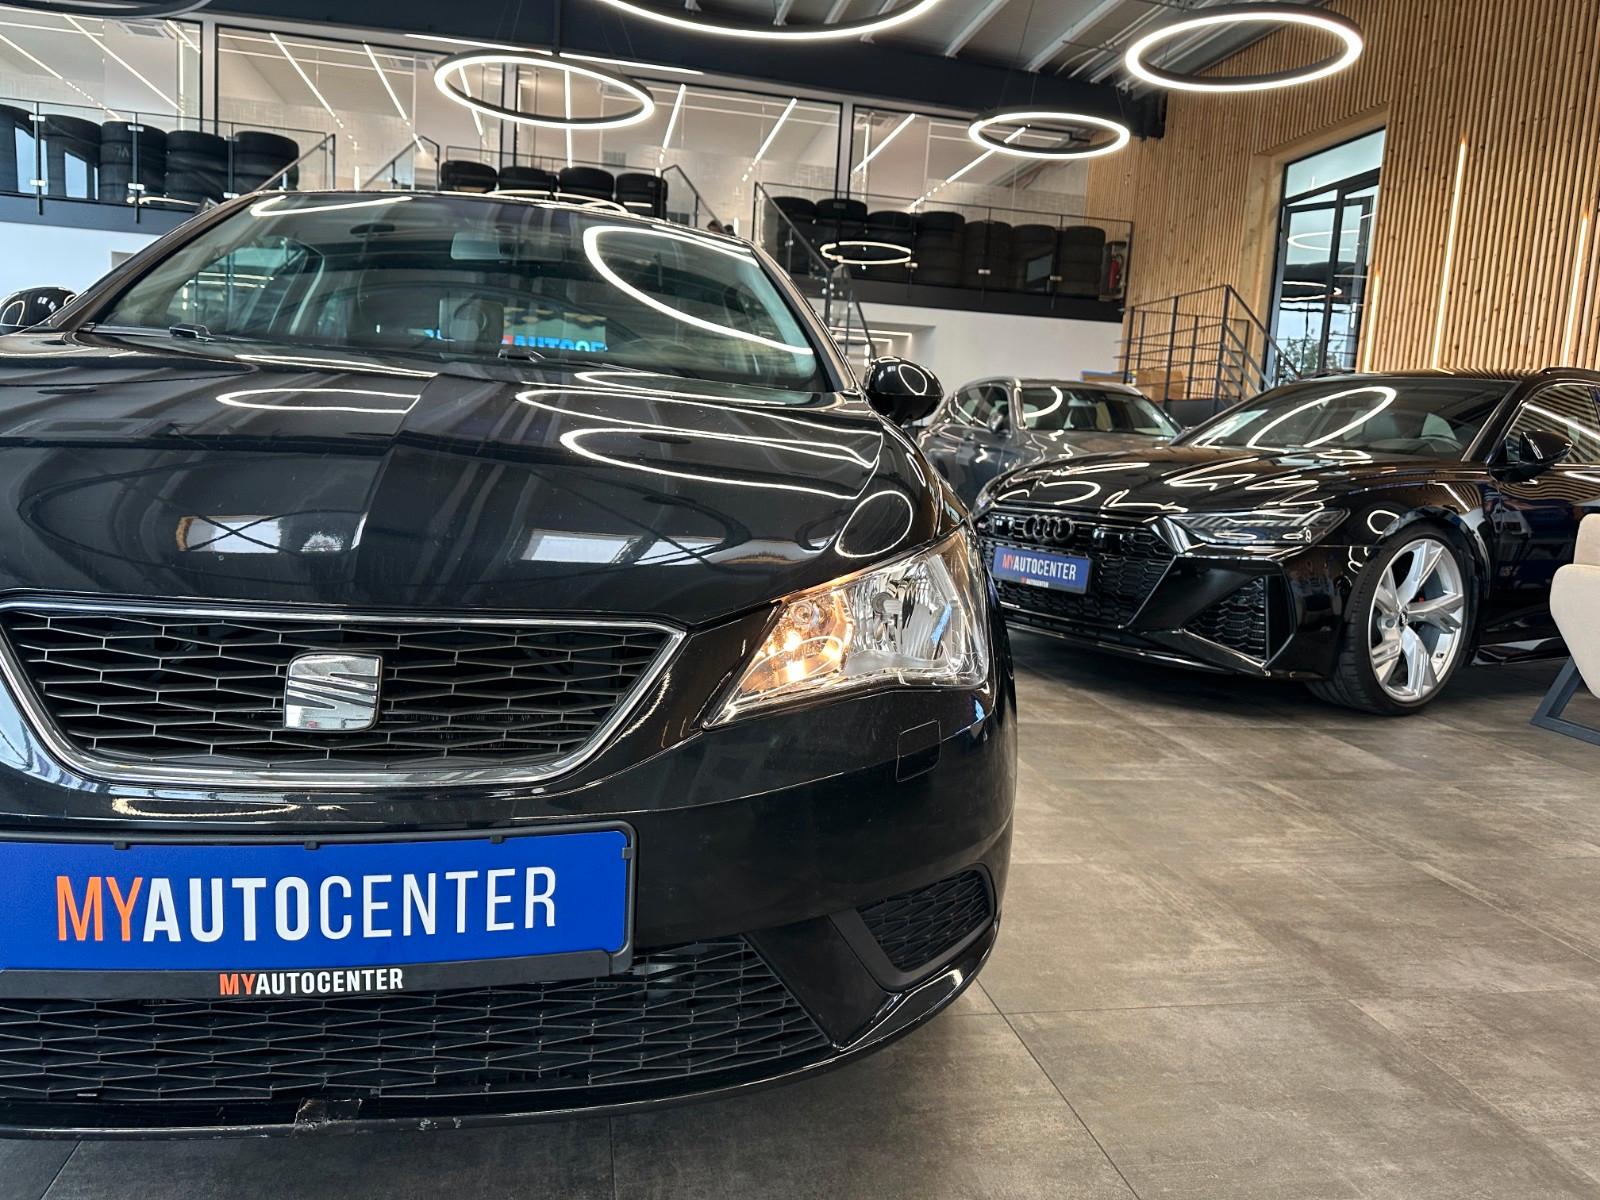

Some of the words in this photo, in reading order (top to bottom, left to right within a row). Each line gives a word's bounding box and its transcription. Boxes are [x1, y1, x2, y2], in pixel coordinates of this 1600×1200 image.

[1002, 554, 1077, 581] MYAUTOCENTER
[56, 866, 556, 943] MYAUTOCENTER
[219, 967, 404, 996] MYAUTOCENTER
